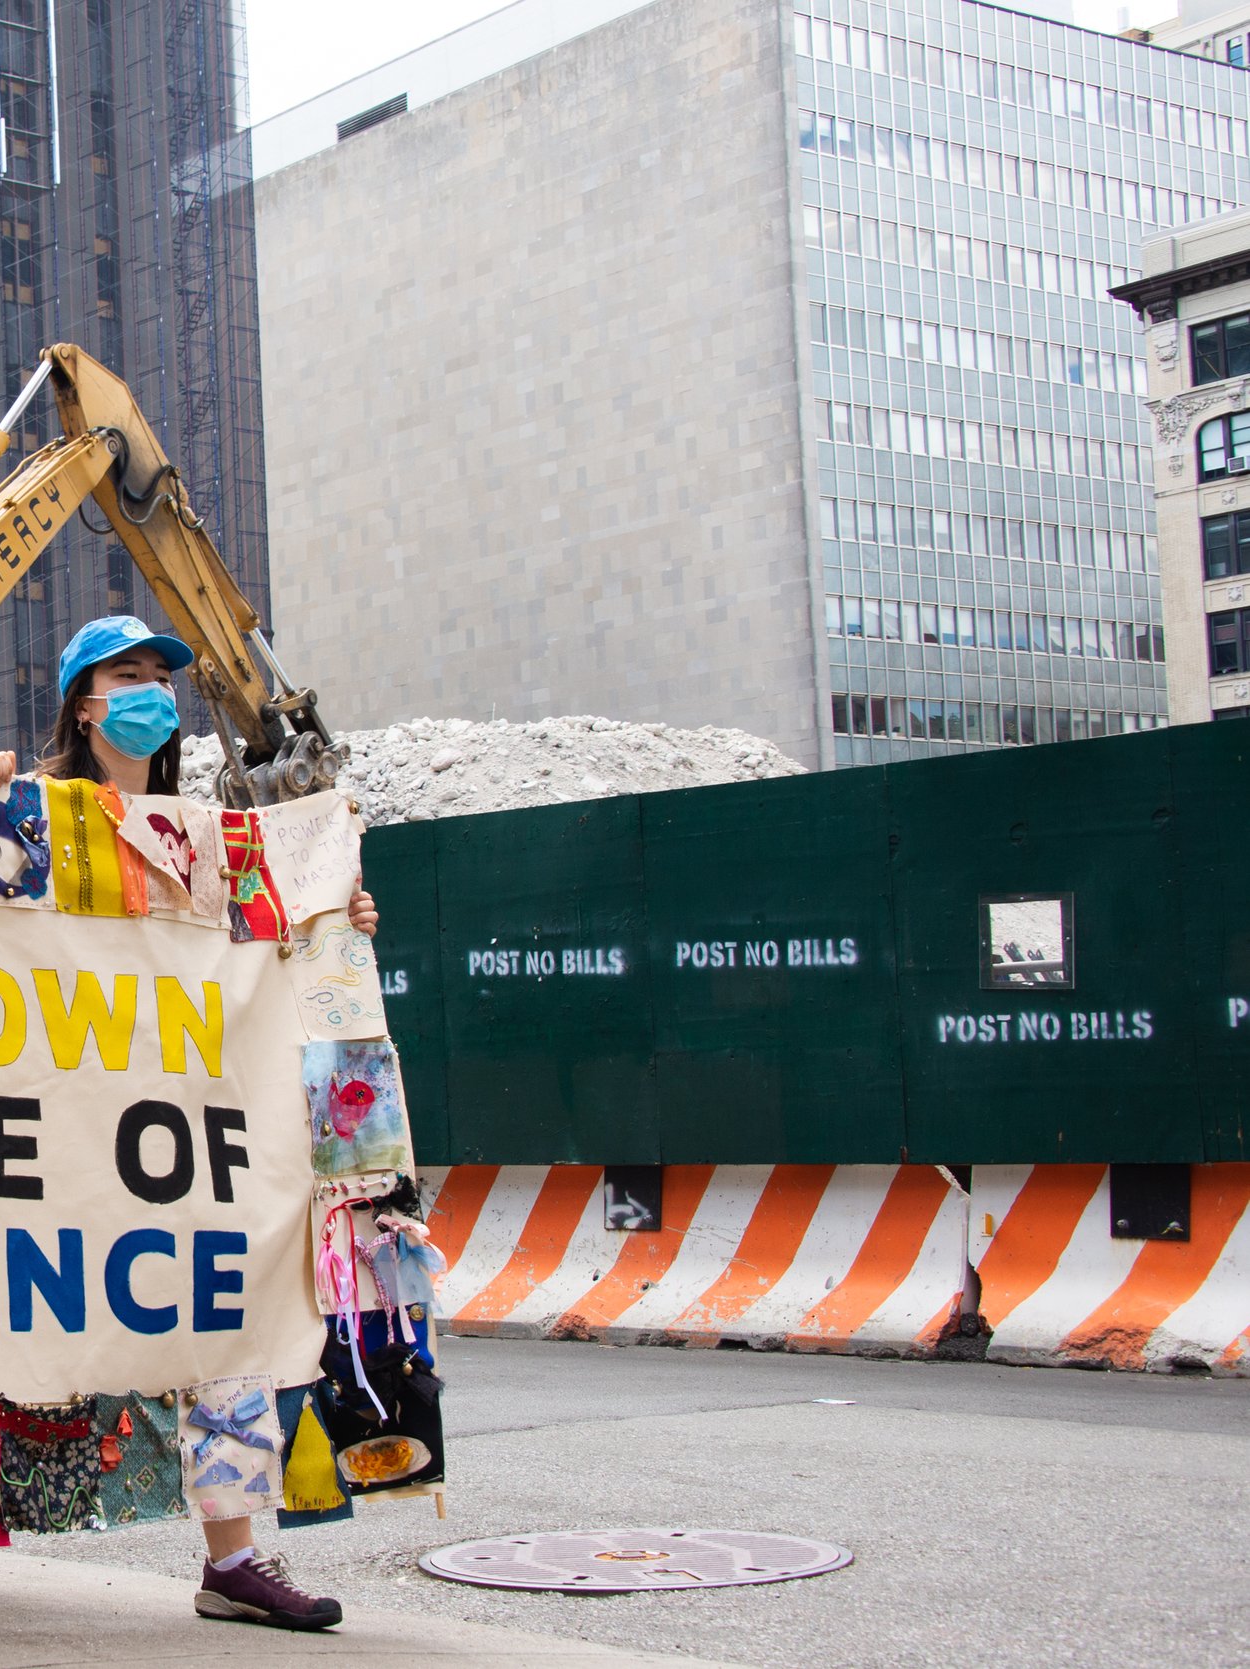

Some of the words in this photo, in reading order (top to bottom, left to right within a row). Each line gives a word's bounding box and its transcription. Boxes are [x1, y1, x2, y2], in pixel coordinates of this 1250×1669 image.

[277, 812, 339, 847] POWER
[287, 847, 310, 866] TO
[318, 829, 355, 854] THE
[468, 950, 519, 976] POST
[525, 950, 555, 975] NO
[562, 947, 625, 975] BILLS
[676, 941, 737, 967] POST
[745, 940, 779, 967] NO
[787, 937, 858, 966] BILLS
[938, 1014, 1011, 1042] POST
[1019, 1011, 1060, 1041] NO
[1070, 1010, 1153, 1040] BILLS
[115, 1099, 250, 1205] OF
[214, 1436, 226, 1449] THE
